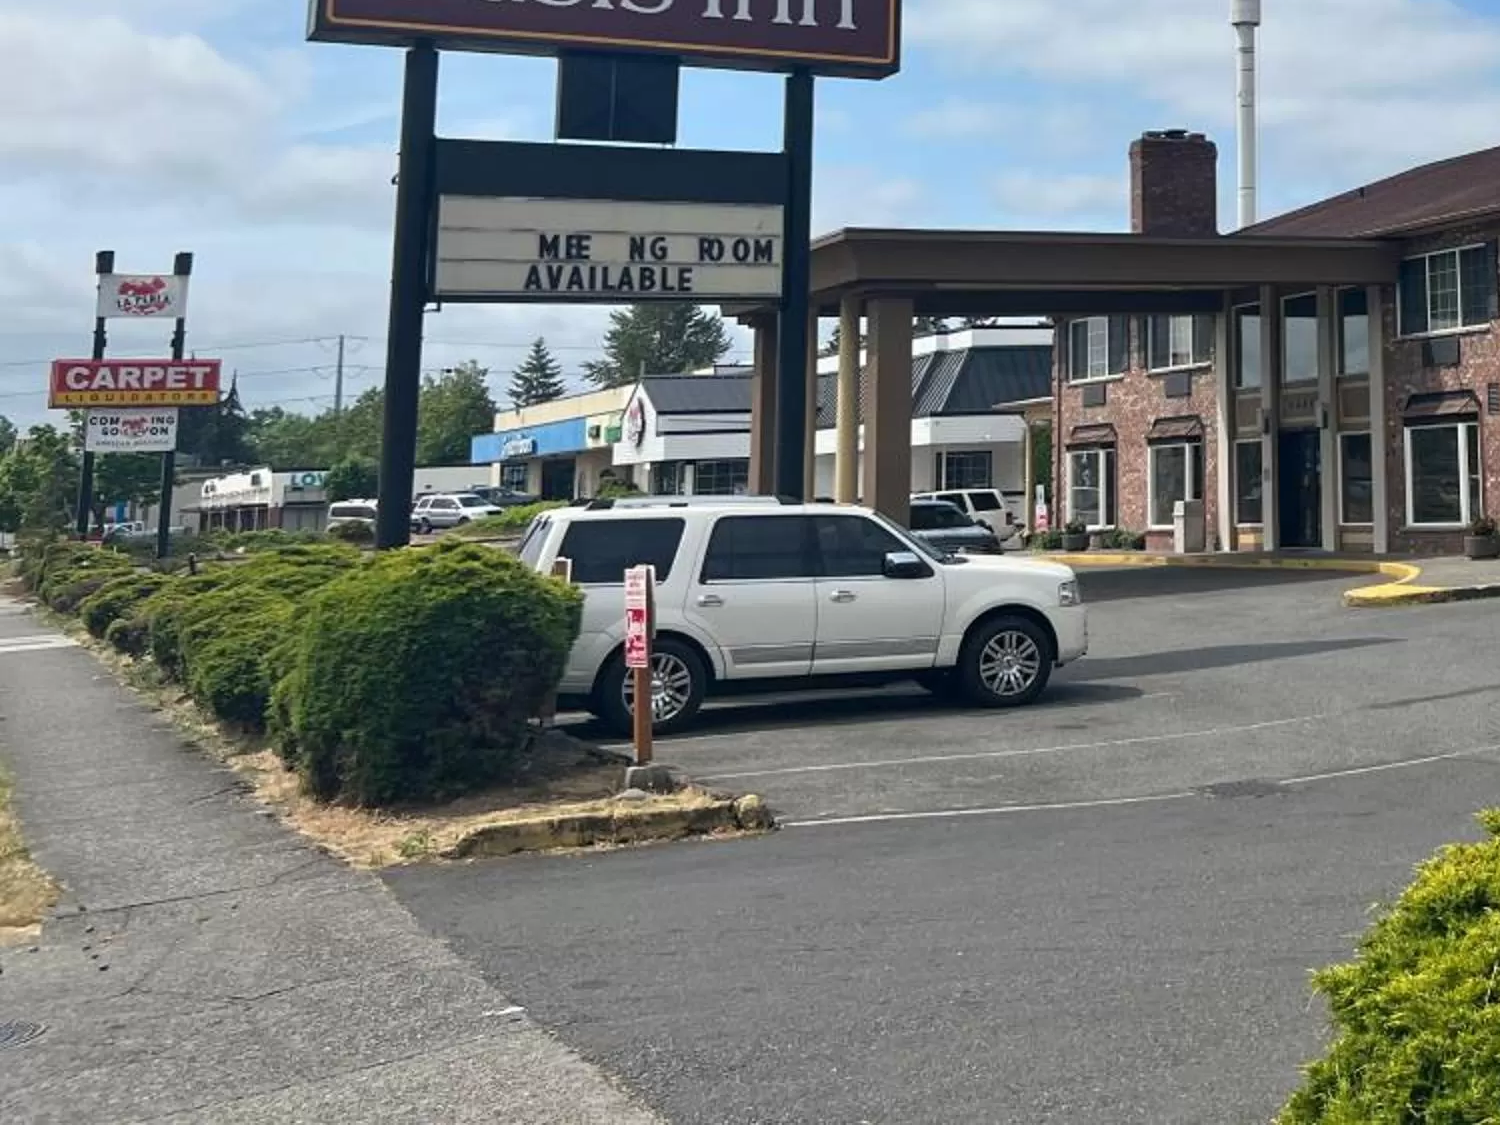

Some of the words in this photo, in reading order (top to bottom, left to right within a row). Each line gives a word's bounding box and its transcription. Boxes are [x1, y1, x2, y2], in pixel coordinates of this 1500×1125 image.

[699, 237, 774, 264] ROOM
[523, 264, 694, 293] AVAILABLE
[65, 366, 211, 390] CARPET
[65, 393, 209, 402] LIQUIDATORS
